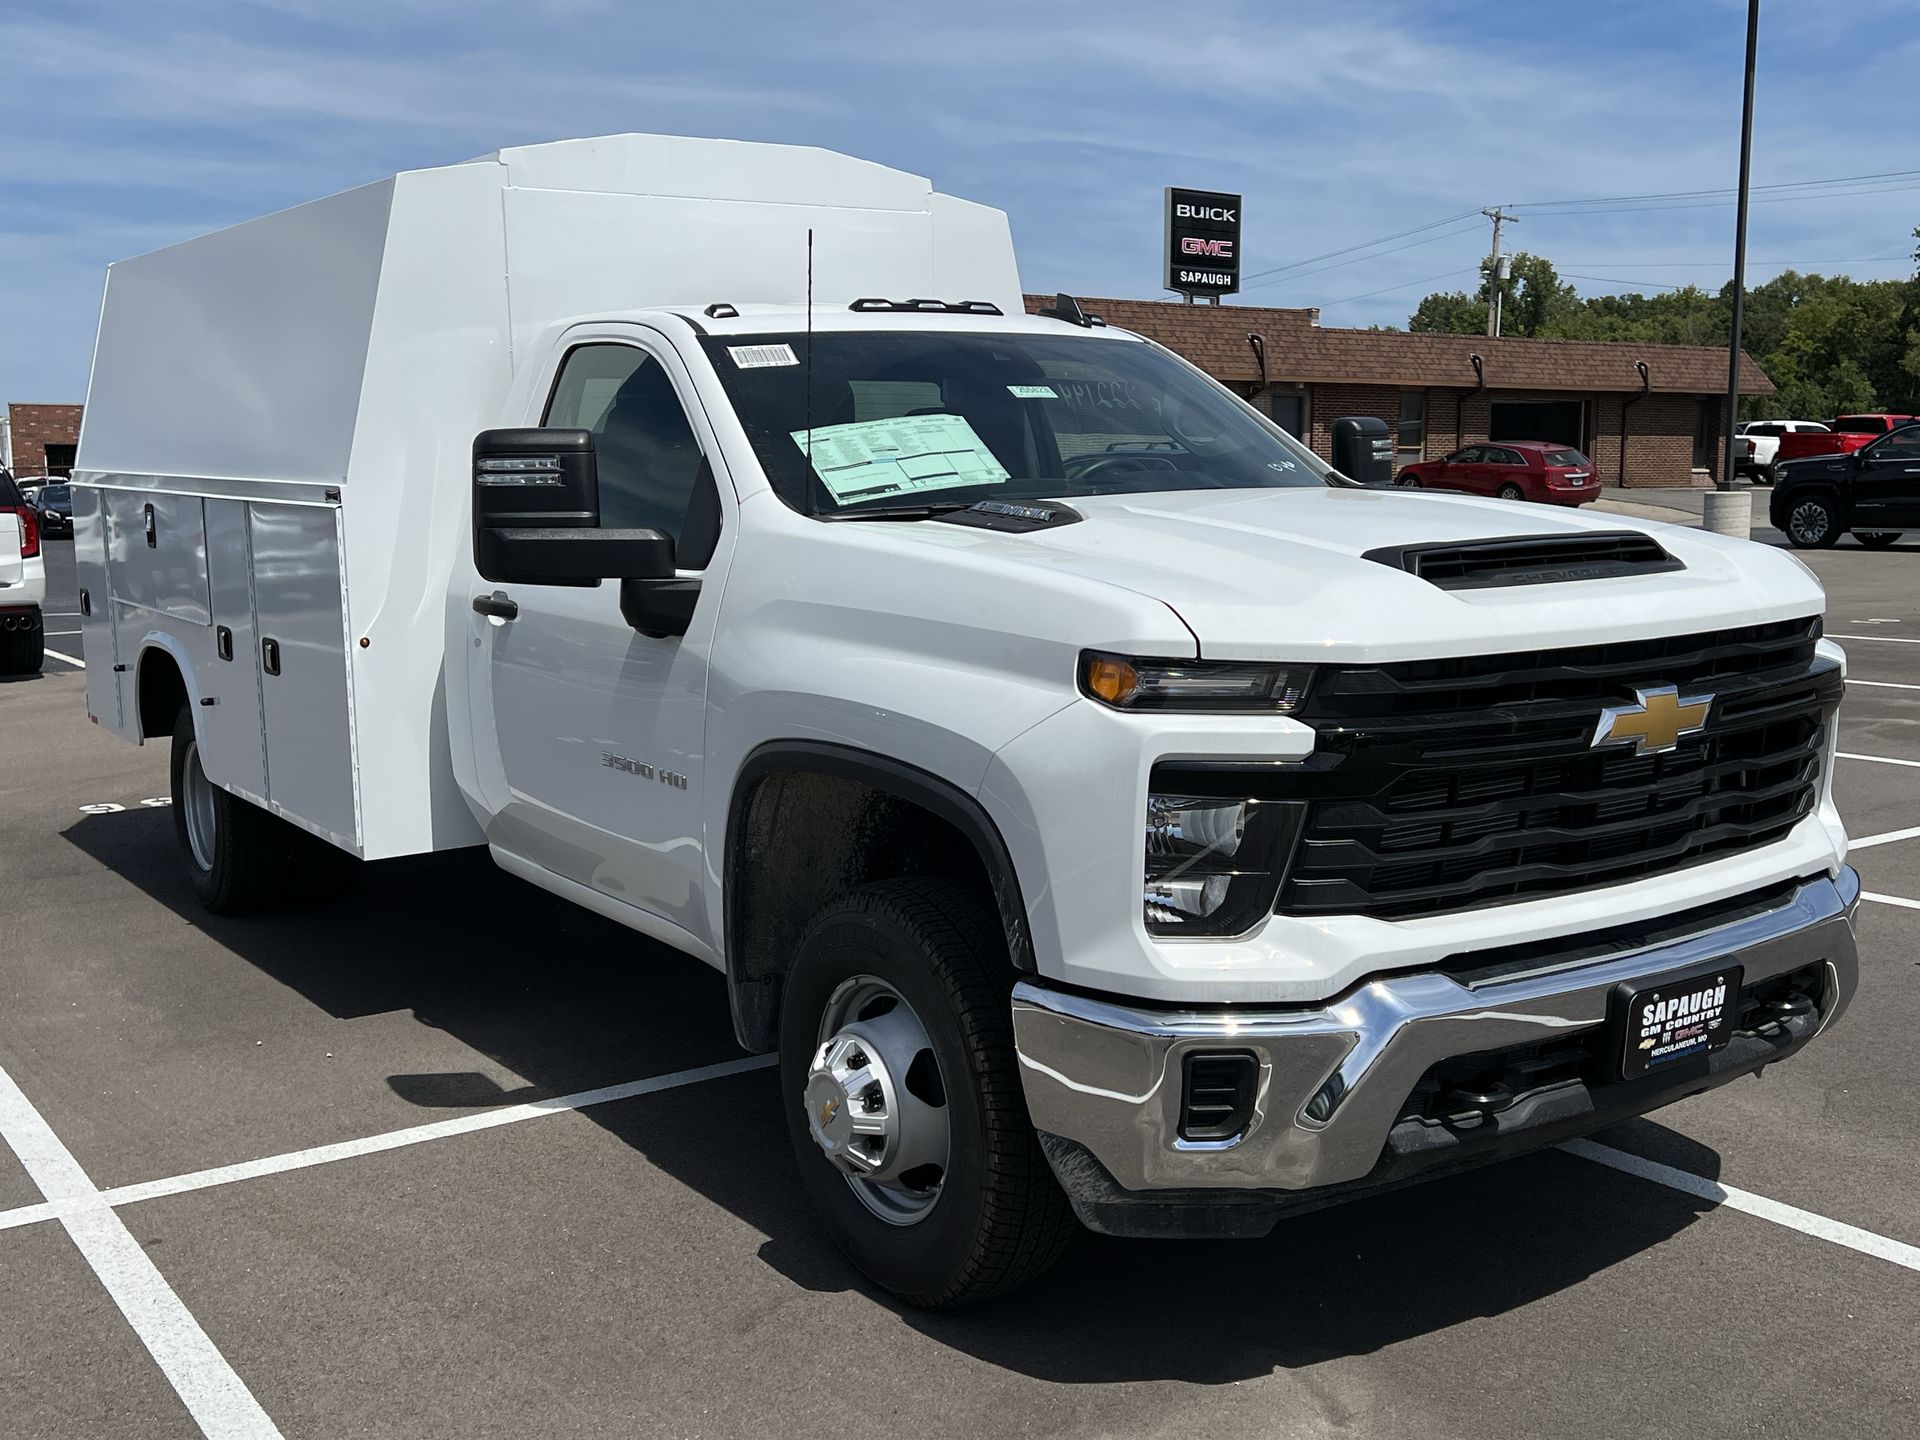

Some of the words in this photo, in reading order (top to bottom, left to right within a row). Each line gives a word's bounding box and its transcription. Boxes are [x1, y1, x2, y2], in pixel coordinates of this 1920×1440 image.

[1176, 204, 1236, 222] BUICK
[1181, 237, 1233, 257] GMC
[1180, 271, 1231, 285] SAPAUGH
[601, 751, 654, 780] 3500
[659, 768, 688, 790] HD
[1642, 985, 1726, 1026] SAPAUGH
[1640, 1024, 1661, 1038] GM
[1665, 1007, 1722, 1031] COUNTRY
[1675, 1024, 1704, 1040] GMC
[1697, 1034, 1708, 1044] MO
